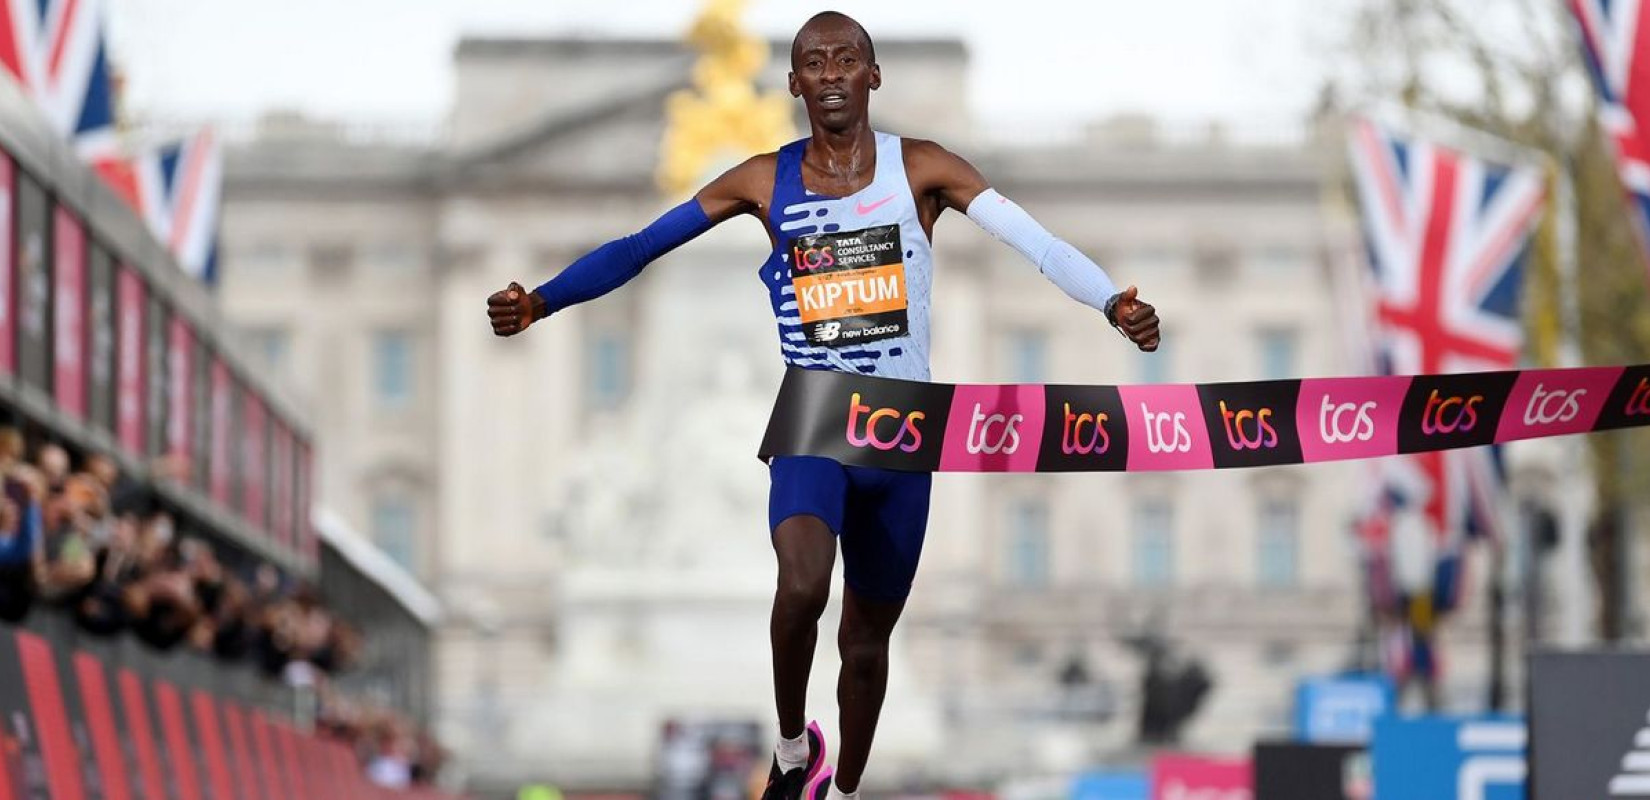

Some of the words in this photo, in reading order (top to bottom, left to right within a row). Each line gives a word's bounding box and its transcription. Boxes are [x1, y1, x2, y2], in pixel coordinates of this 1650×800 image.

[836, 238, 862, 248] TATA
[837, 242, 894, 256] CONSULTANCY
[794, 246, 834, 270] tcs
[838, 253, 876, 266] SERVICES
[801, 275, 899, 312] KIPTUM
[842, 330, 861, 339] new
[863, 324, 900, 336] balance
[845, 392, 926, 454] tcs
[965, 402, 1024, 455] tcs
[1061, 402, 1110, 455] tcs
[1141, 402, 1192, 454] tcs
[1219, 400, 1279, 451] tcs
[1319, 393, 1378, 444] tcs
[1420, 388, 1485, 436] tcs
[1523, 382, 1587, 427] tcs
